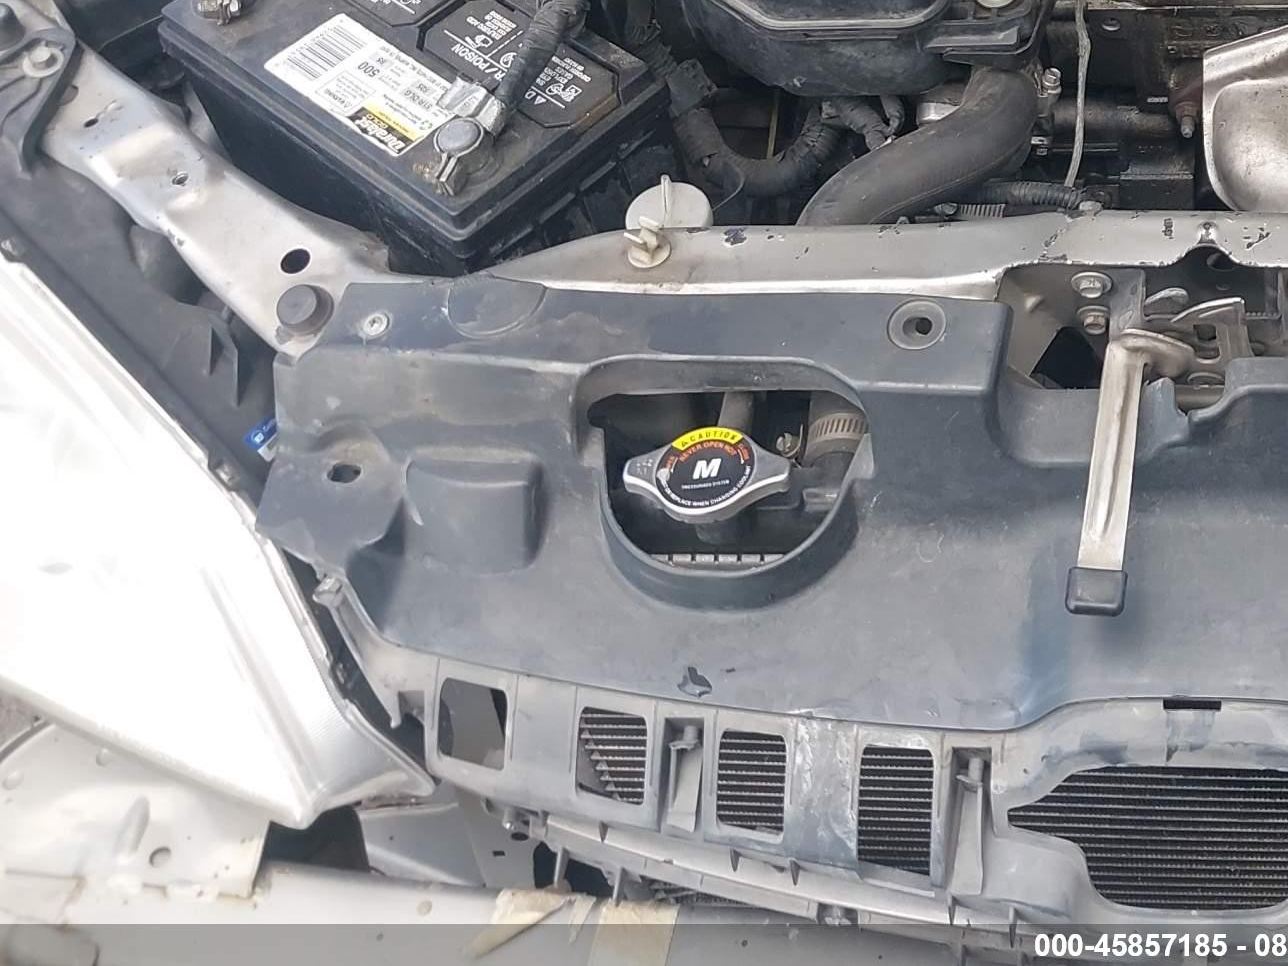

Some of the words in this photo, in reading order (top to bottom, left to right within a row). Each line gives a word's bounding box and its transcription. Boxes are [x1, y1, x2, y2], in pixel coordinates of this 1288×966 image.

[355, 60, 381, 77] 500
[364, 112, 389, 129] GOLD
[352, 114, 407, 151] Duralast
[690, 431, 737, 441] CAUTION
[692, 458, 721, 480] M
